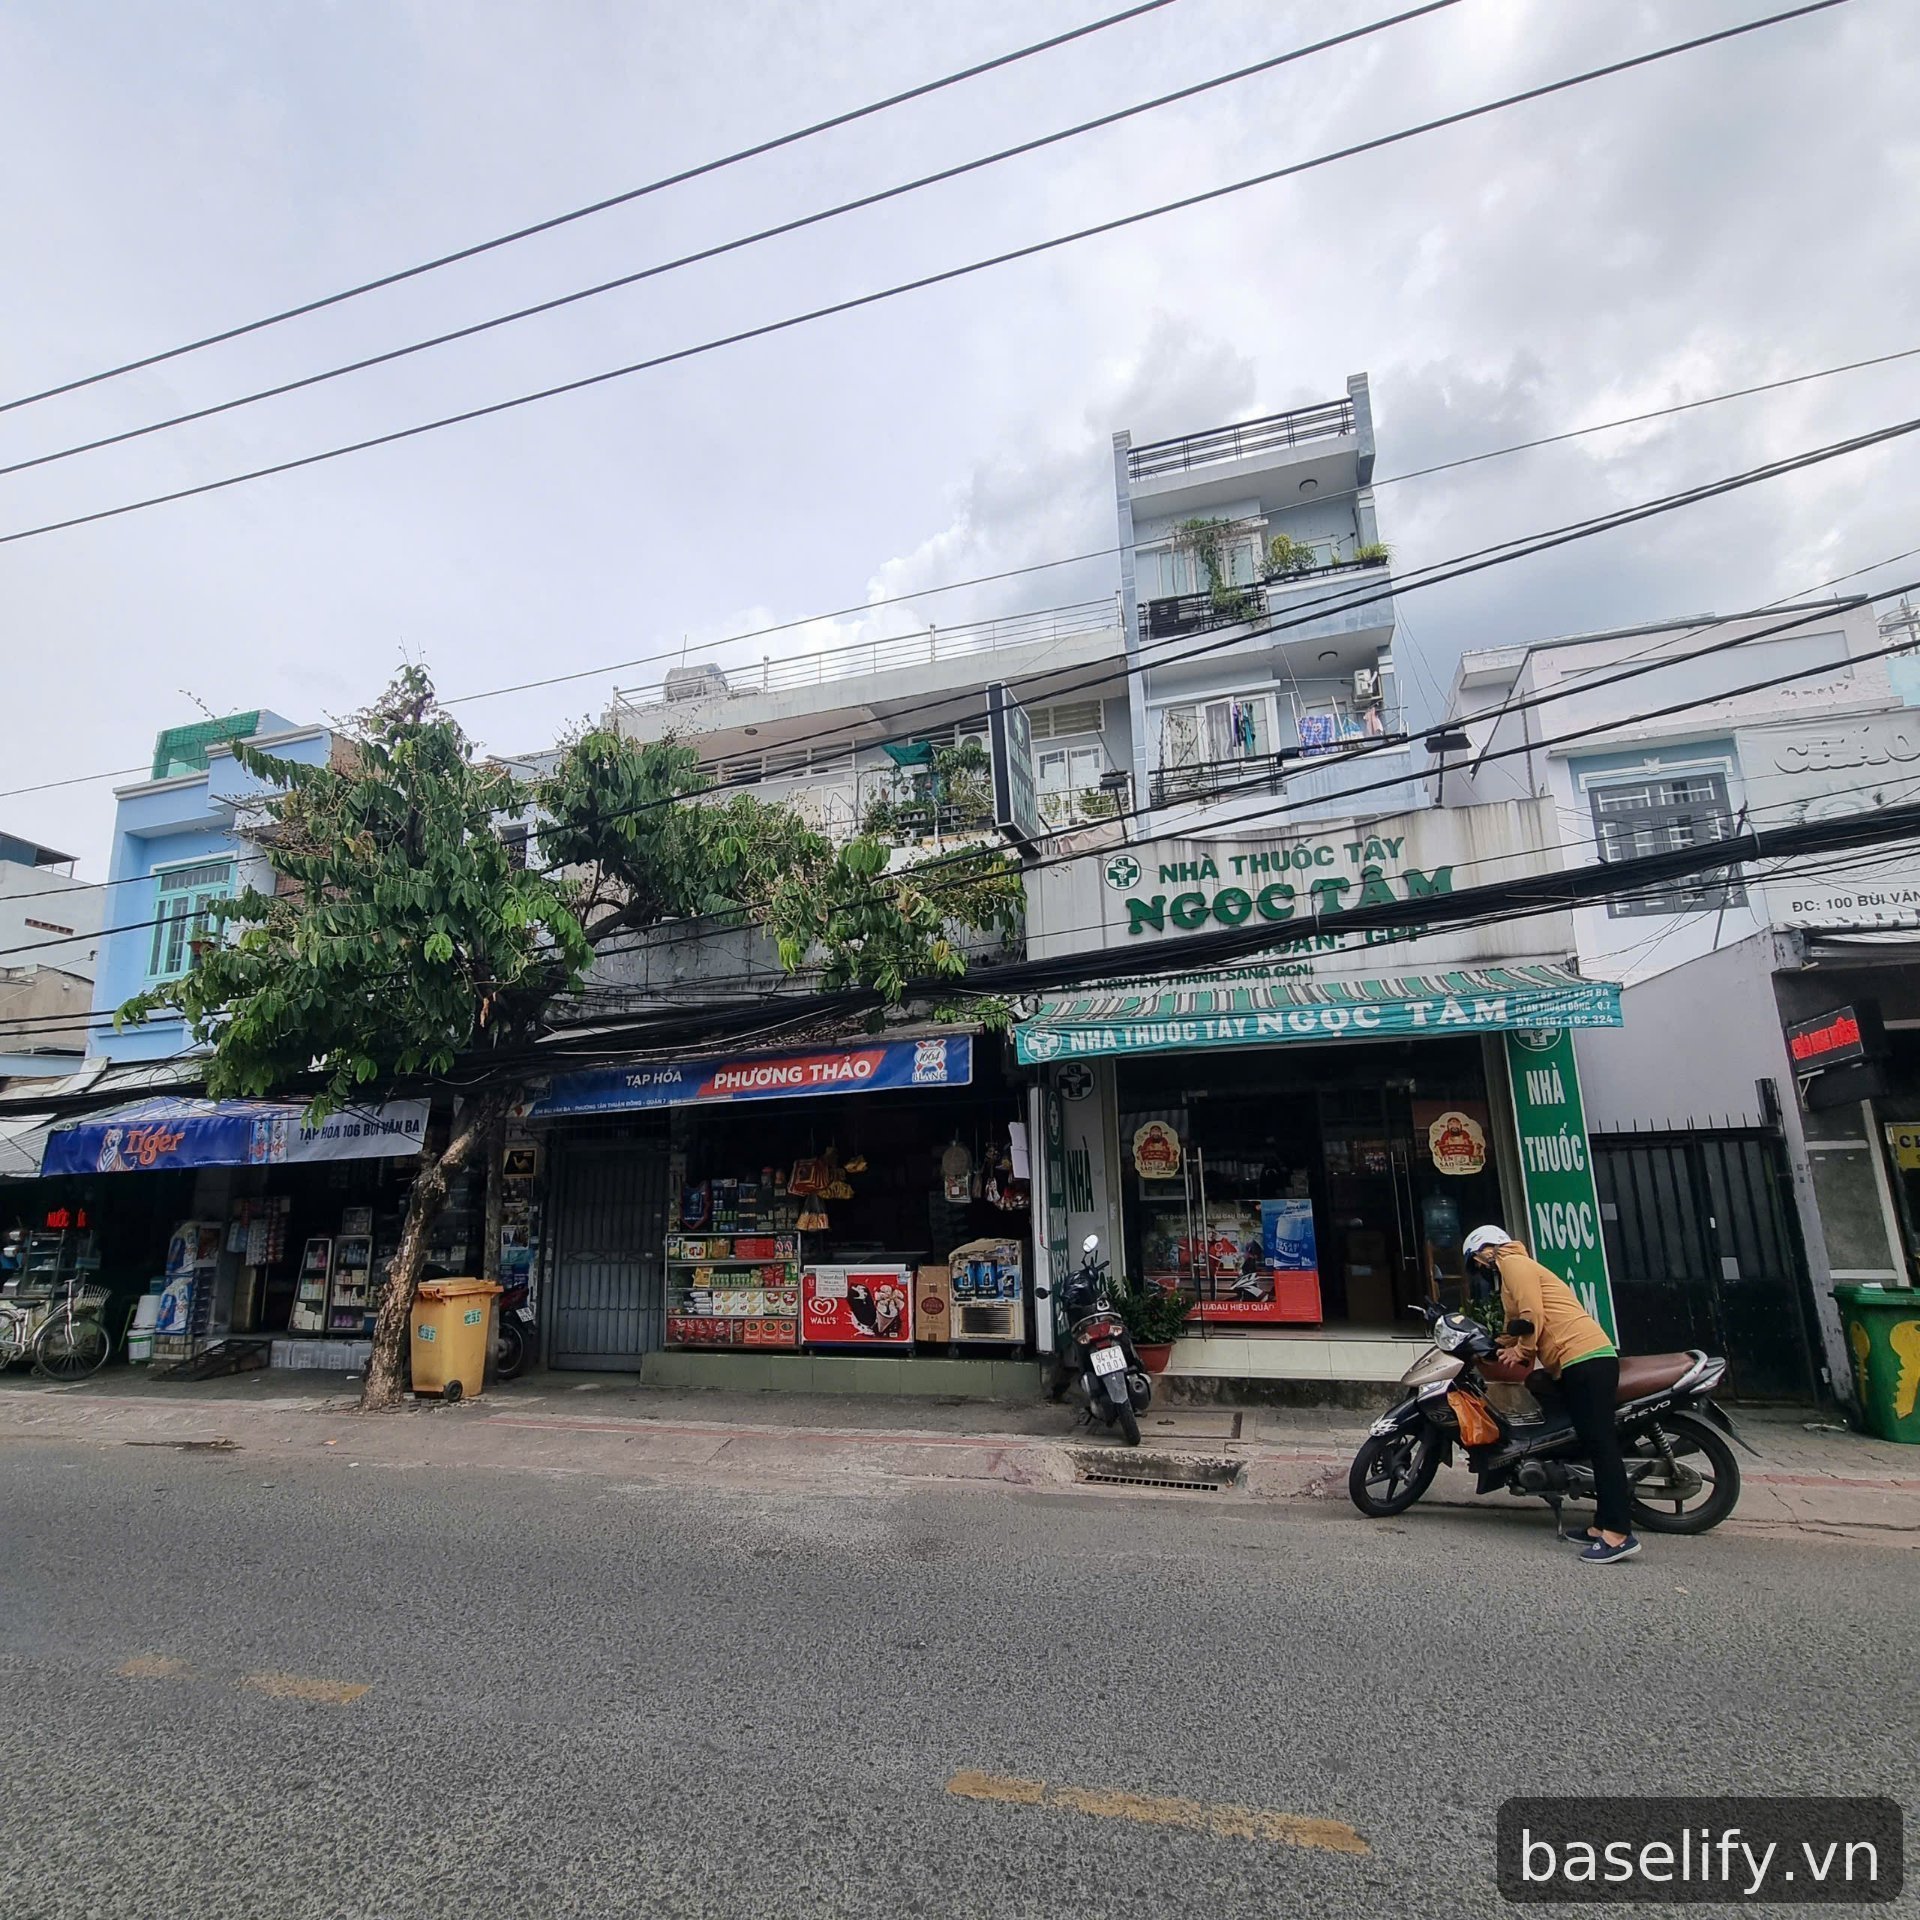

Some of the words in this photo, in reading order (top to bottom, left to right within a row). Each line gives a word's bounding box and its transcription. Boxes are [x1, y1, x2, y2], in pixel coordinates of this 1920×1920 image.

[1159, 852, 1219, 884] NHÀ
[1229, 838, 1335, 875] THUỐC
[1343, 834, 1405, 864] TÂY
[1311, 865, 1453, 914] TÂM
[1792, 900, 1821, 912] ĐC:
[1826, 896, 1853, 910] 100
[1858, 891, 1885, 907] BÙI
[1595, 988, 1609, 997] BA
[1070, 1024, 1117, 1051] NHÀ
[1203, 1015, 1246, 1039] TÂY
[1257, 1006, 1381, 1037] NGỌC
[625, 1074, 651, 1089] TẠP
[653, 1069, 682, 1084] HÓA
[713, 1066, 803, 1089] PHƯƠNG
[809, 1056, 872, 1081] THẢO
[912, 1070, 947, 1082] BLANC
[1526, 1062, 1566, 1106] NHÀ
[124, 1126, 186, 1165] Tiger
[343, 1124, 361, 1138] 106
[405, 1119, 420, 1133] BA
[1524, 1122, 1584, 1173] THUỐC
[1535, 1201, 1595, 1264] NGỌC
[810, 1316, 838, 1325] WALL'S
[1624, 1400, 1671, 1422] REVO
